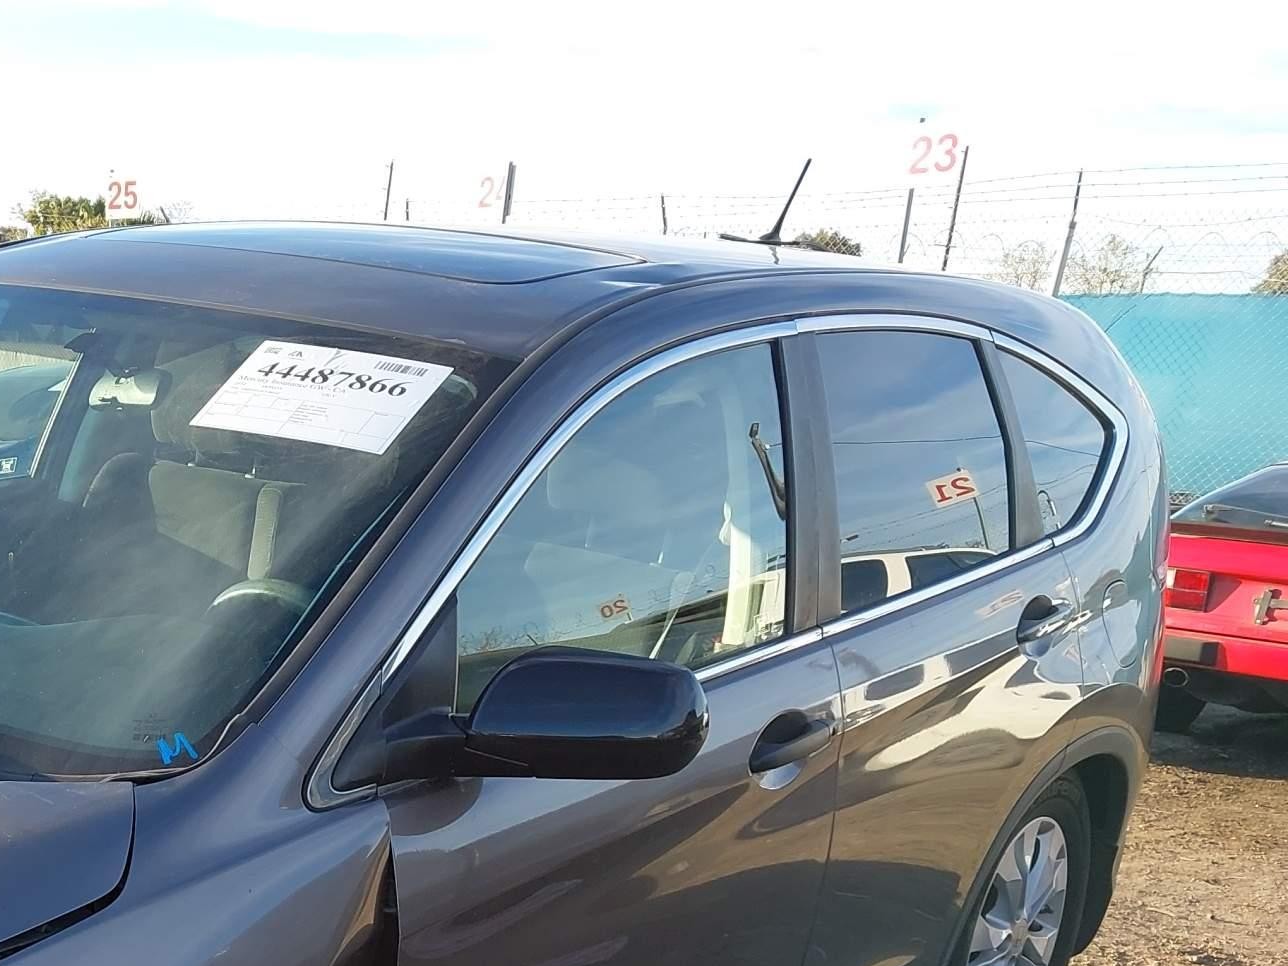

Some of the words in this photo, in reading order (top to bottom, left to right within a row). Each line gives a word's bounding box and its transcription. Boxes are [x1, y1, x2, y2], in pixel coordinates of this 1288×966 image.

[908, 133, 959, 175] 23
[107, 180, 138, 210] 25
[257, 361, 413, 398] 44487866
